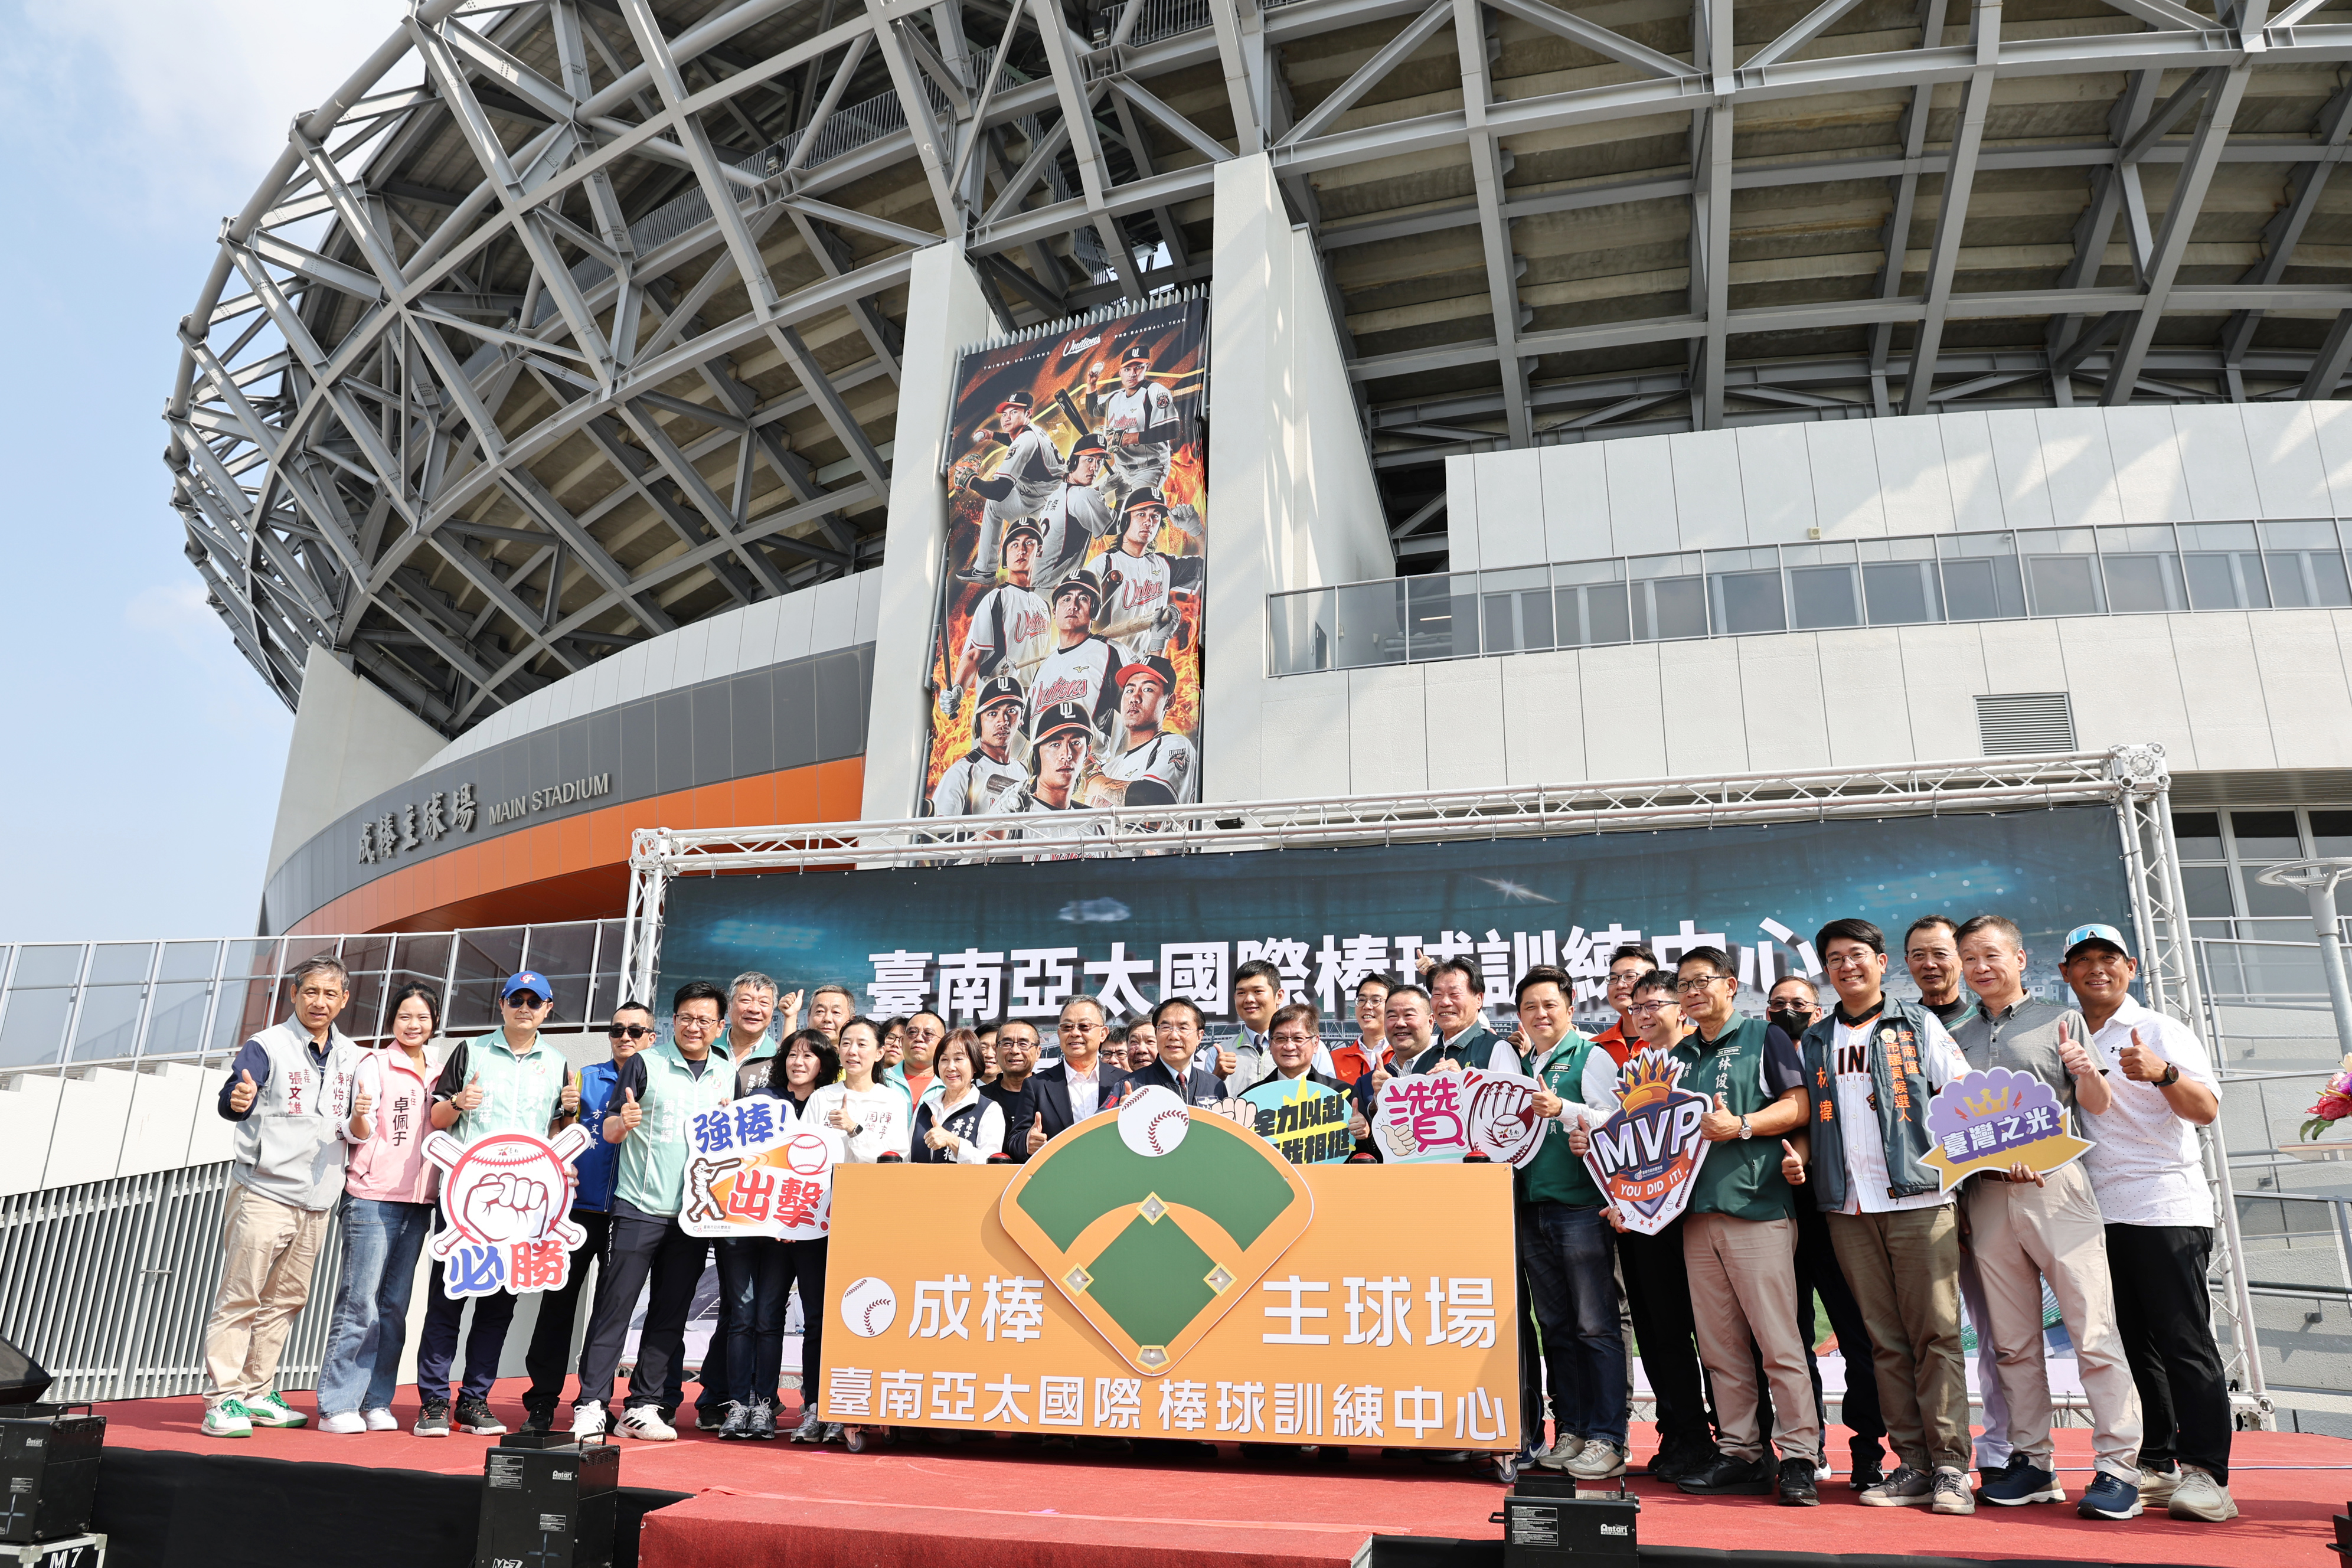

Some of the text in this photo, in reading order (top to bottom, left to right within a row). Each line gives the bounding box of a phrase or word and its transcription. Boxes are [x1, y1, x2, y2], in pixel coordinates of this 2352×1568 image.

[1063, 334, 1101, 357] Unilions
[1131, 324, 1165, 336] BASEBALL
[1168, 318, 1187, 326] TEAM
[984, 351, 1050, 370] TAINAN UNILIONS
[489, 773, 609, 825] MAIN STADIUM
[358, 782, 476, 865] 成棒主球場
[1898, 1031, 1920, 1075] 安南區
[288, 1072, 303, 1115] 張文雄
[1885, 1042, 1912, 1122] 市議員候選人
[589, 1109, 602, 1150] 方文賢
[693, 1103, 786, 1154] 強棒!
[1255, 1093, 1344, 1137] 全力以赴
[1595, 1100, 1704, 1174] MVP
[1942, 1106, 2053, 1160] 臺灣之光
[1620, 1184, 1641, 1197] YOU
[1647, 1180, 1664, 1195] DID
[1669, 1168, 1683, 1185] IT!
[450, 1240, 564, 1293] 必勝
[909, 1274, 1495, 1349] 成棒 主球場
[828, 1367, 1507, 1441] 臺南亞太國際棒球訓練中心
[1600, 1524, 1628, 1533] Antari
